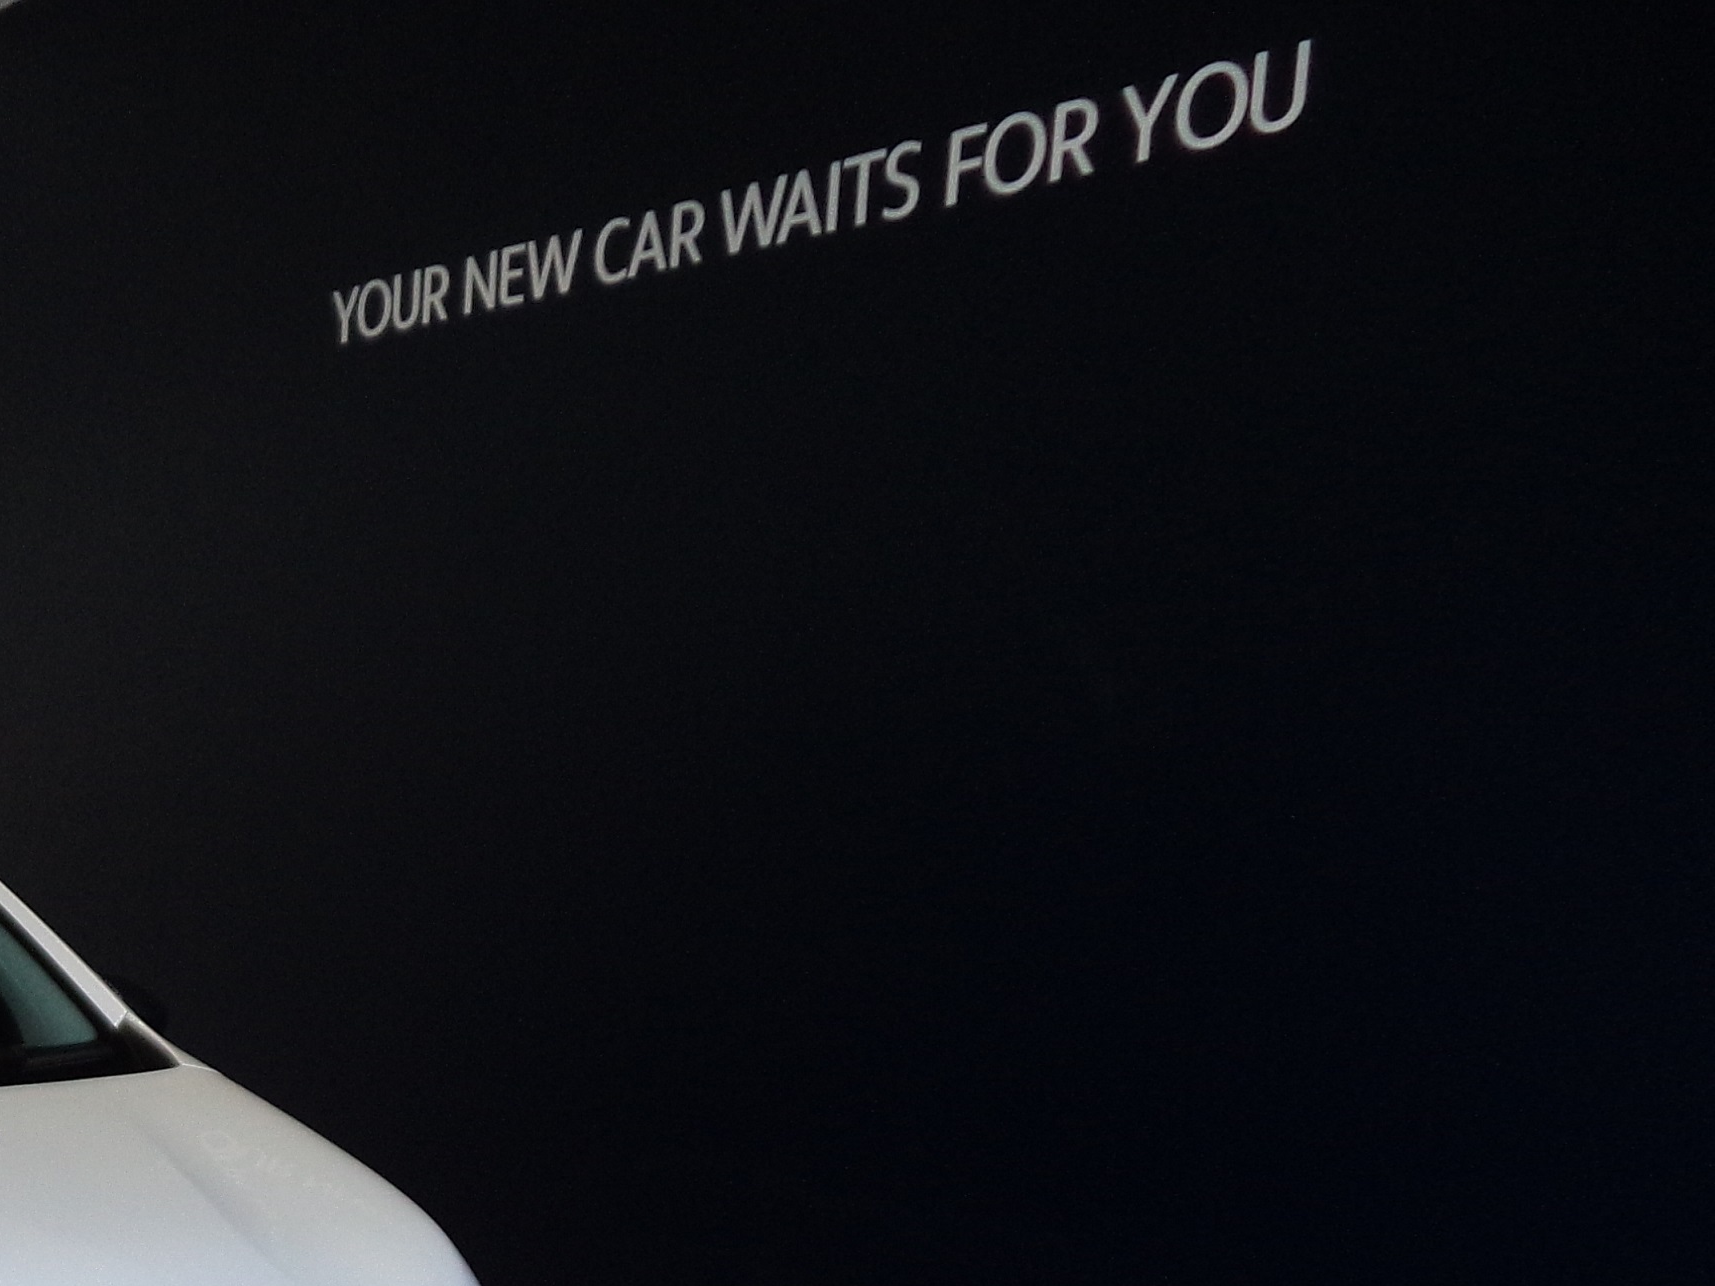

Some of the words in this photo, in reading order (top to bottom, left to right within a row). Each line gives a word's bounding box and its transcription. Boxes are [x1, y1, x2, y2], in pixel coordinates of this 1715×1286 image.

[332, 264, 450, 344] YOUR
[462, 229, 583, 315] NEW
[594, 201, 706, 284] CAR
[721, 141, 922, 254] WAITS
[944, 99, 1099, 207] FOR
[1122, 39, 1312, 163] YOU
